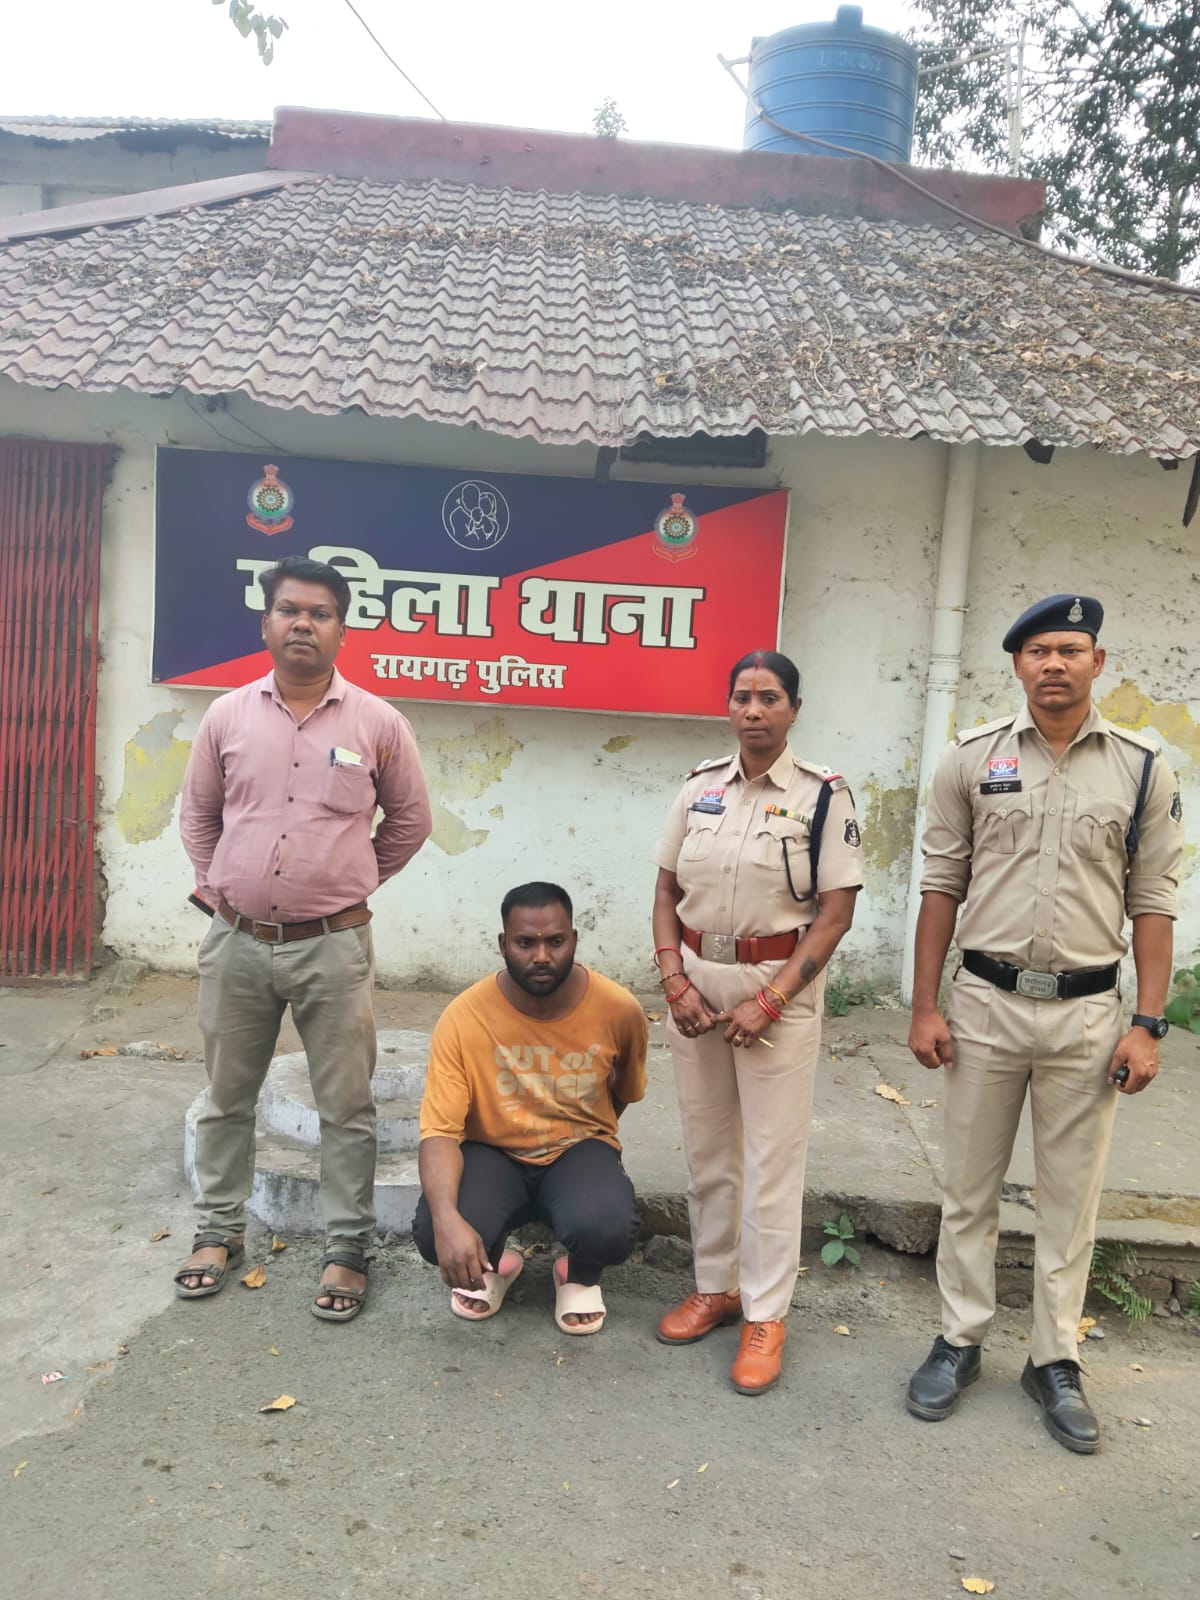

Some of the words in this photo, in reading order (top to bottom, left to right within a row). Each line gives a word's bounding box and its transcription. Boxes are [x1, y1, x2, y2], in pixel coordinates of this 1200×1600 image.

[518, 576, 707, 650] थाना
[369, 653, 471, 690] रायगढ़
[475, 654, 569, 695] पुलिस
[495, 1043, 556, 1072] OUT
